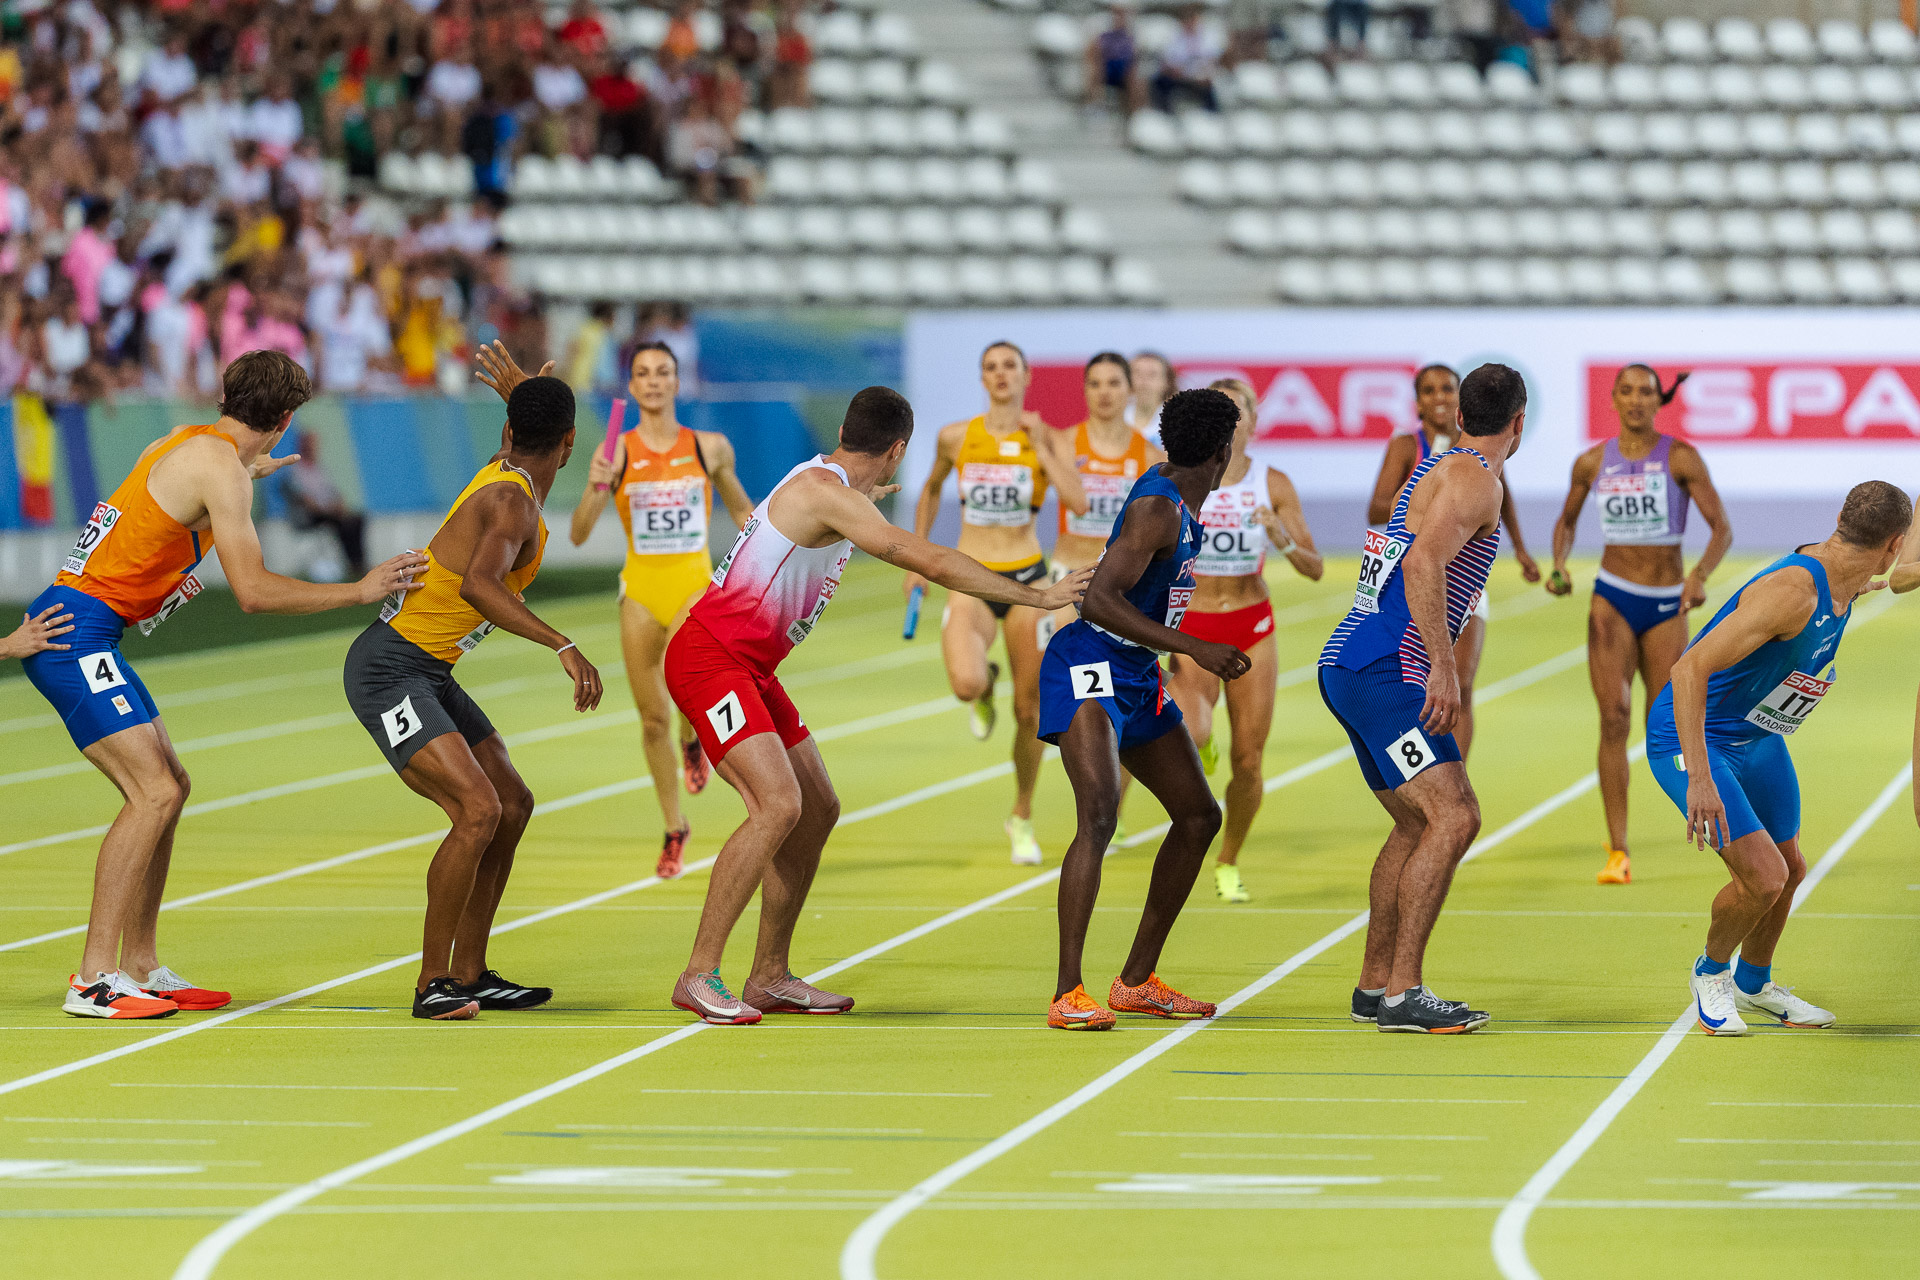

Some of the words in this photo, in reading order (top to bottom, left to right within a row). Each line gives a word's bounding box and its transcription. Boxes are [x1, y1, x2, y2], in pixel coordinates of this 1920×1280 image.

[970, 485, 1019, 506] GER
[1606, 495, 1658, 517] GBR
[647, 509, 690, 531] ESP
[1364, 533, 1386, 553] AR
[1359, 553, 1383, 587] BR
[95, 658, 114, 683] 4
[1082, 669, 1104, 694] 2
[395, 707, 410, 737] 5
[717, 700, 733, 733] 7
[1753, 713, 1793, 733] MADRID
[1401, 740, 1424, 768] 8
